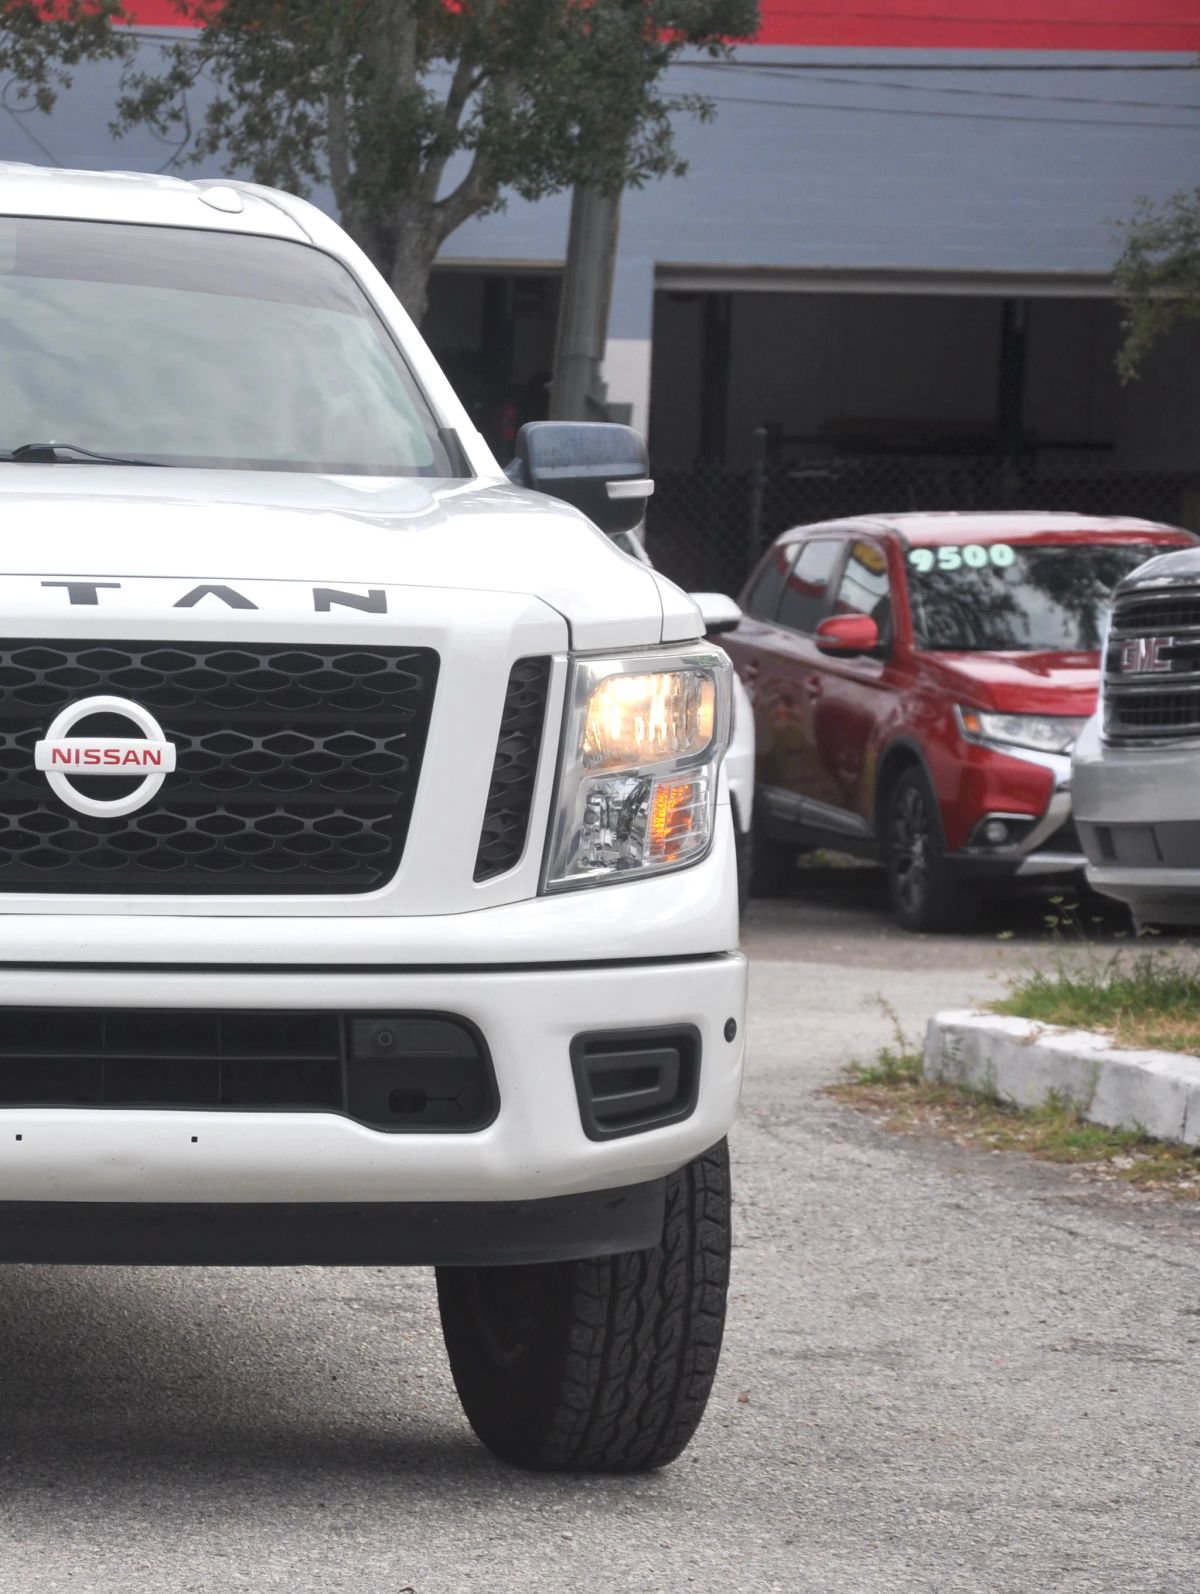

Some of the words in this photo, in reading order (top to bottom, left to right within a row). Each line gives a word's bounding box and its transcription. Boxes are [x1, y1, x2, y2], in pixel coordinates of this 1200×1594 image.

[908, 543, 1015, 572] 9500
[1121, 637, 1174, 673] GMC
[51, 748, 161, 766] NISSAN
